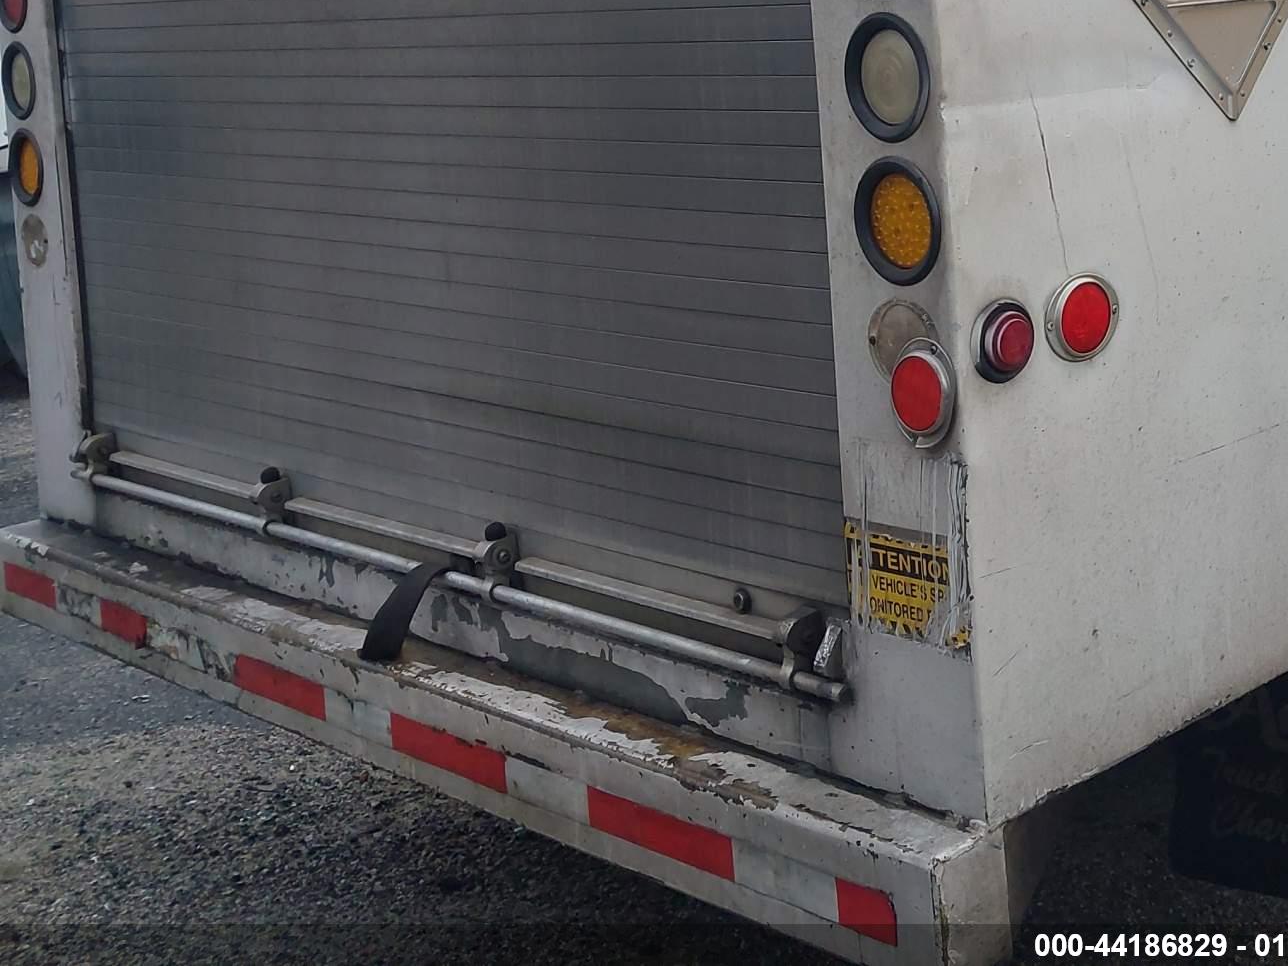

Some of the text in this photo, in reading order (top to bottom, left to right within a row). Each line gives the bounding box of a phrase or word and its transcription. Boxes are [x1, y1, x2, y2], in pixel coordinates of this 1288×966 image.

[857, 544, 949, 581] TENTION
[872, 574, 944, 603] VEHICLE'S SP
[869, 597, 923, 622] ONITORED
